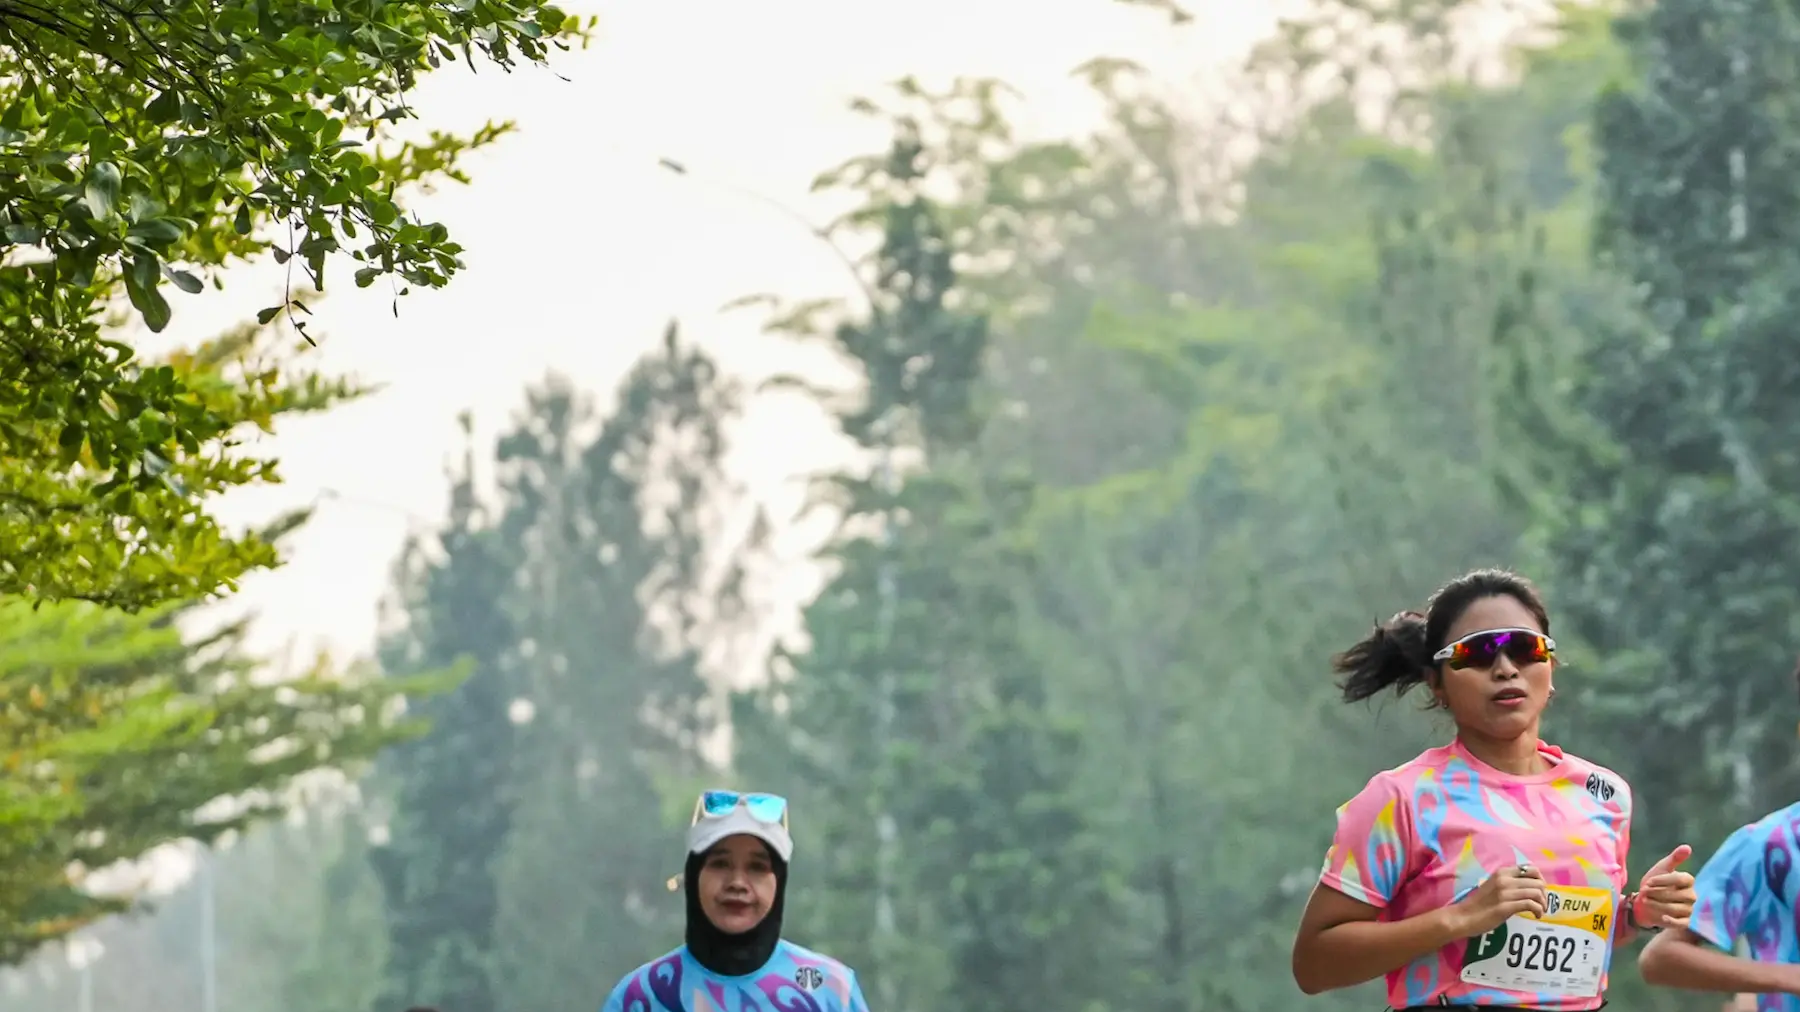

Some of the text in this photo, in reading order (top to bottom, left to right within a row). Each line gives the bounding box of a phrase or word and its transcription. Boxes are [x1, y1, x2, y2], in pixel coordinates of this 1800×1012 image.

[1562, 899, 1591, 912] RUN
[1592, 914, 1607, 931] 5K
[1478, 930, 1576, 973] F 9262
